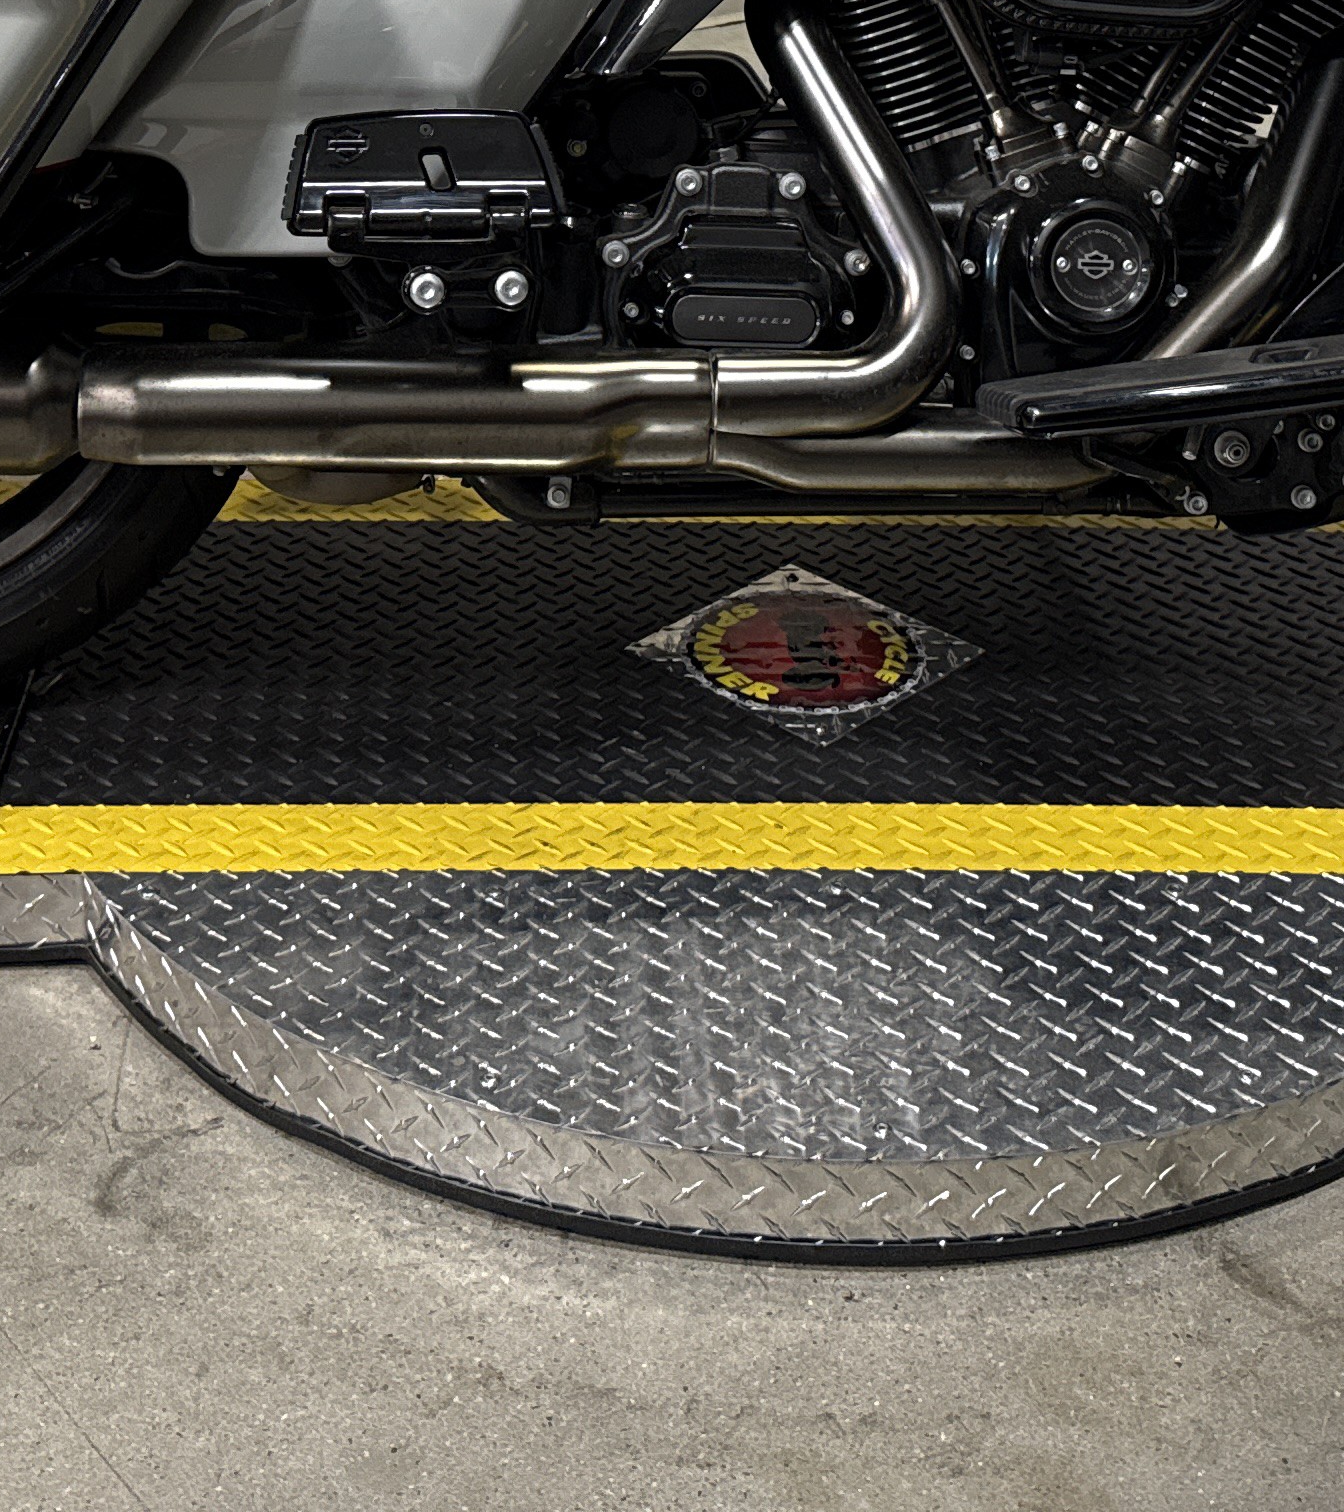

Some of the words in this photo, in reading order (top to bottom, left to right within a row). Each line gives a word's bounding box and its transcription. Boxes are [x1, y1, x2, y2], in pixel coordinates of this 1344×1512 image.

[696, 314, 726, 323] SIX
[736, 316, 792, 325] SPEED
[866, 619, 909, 685] CYCLE
